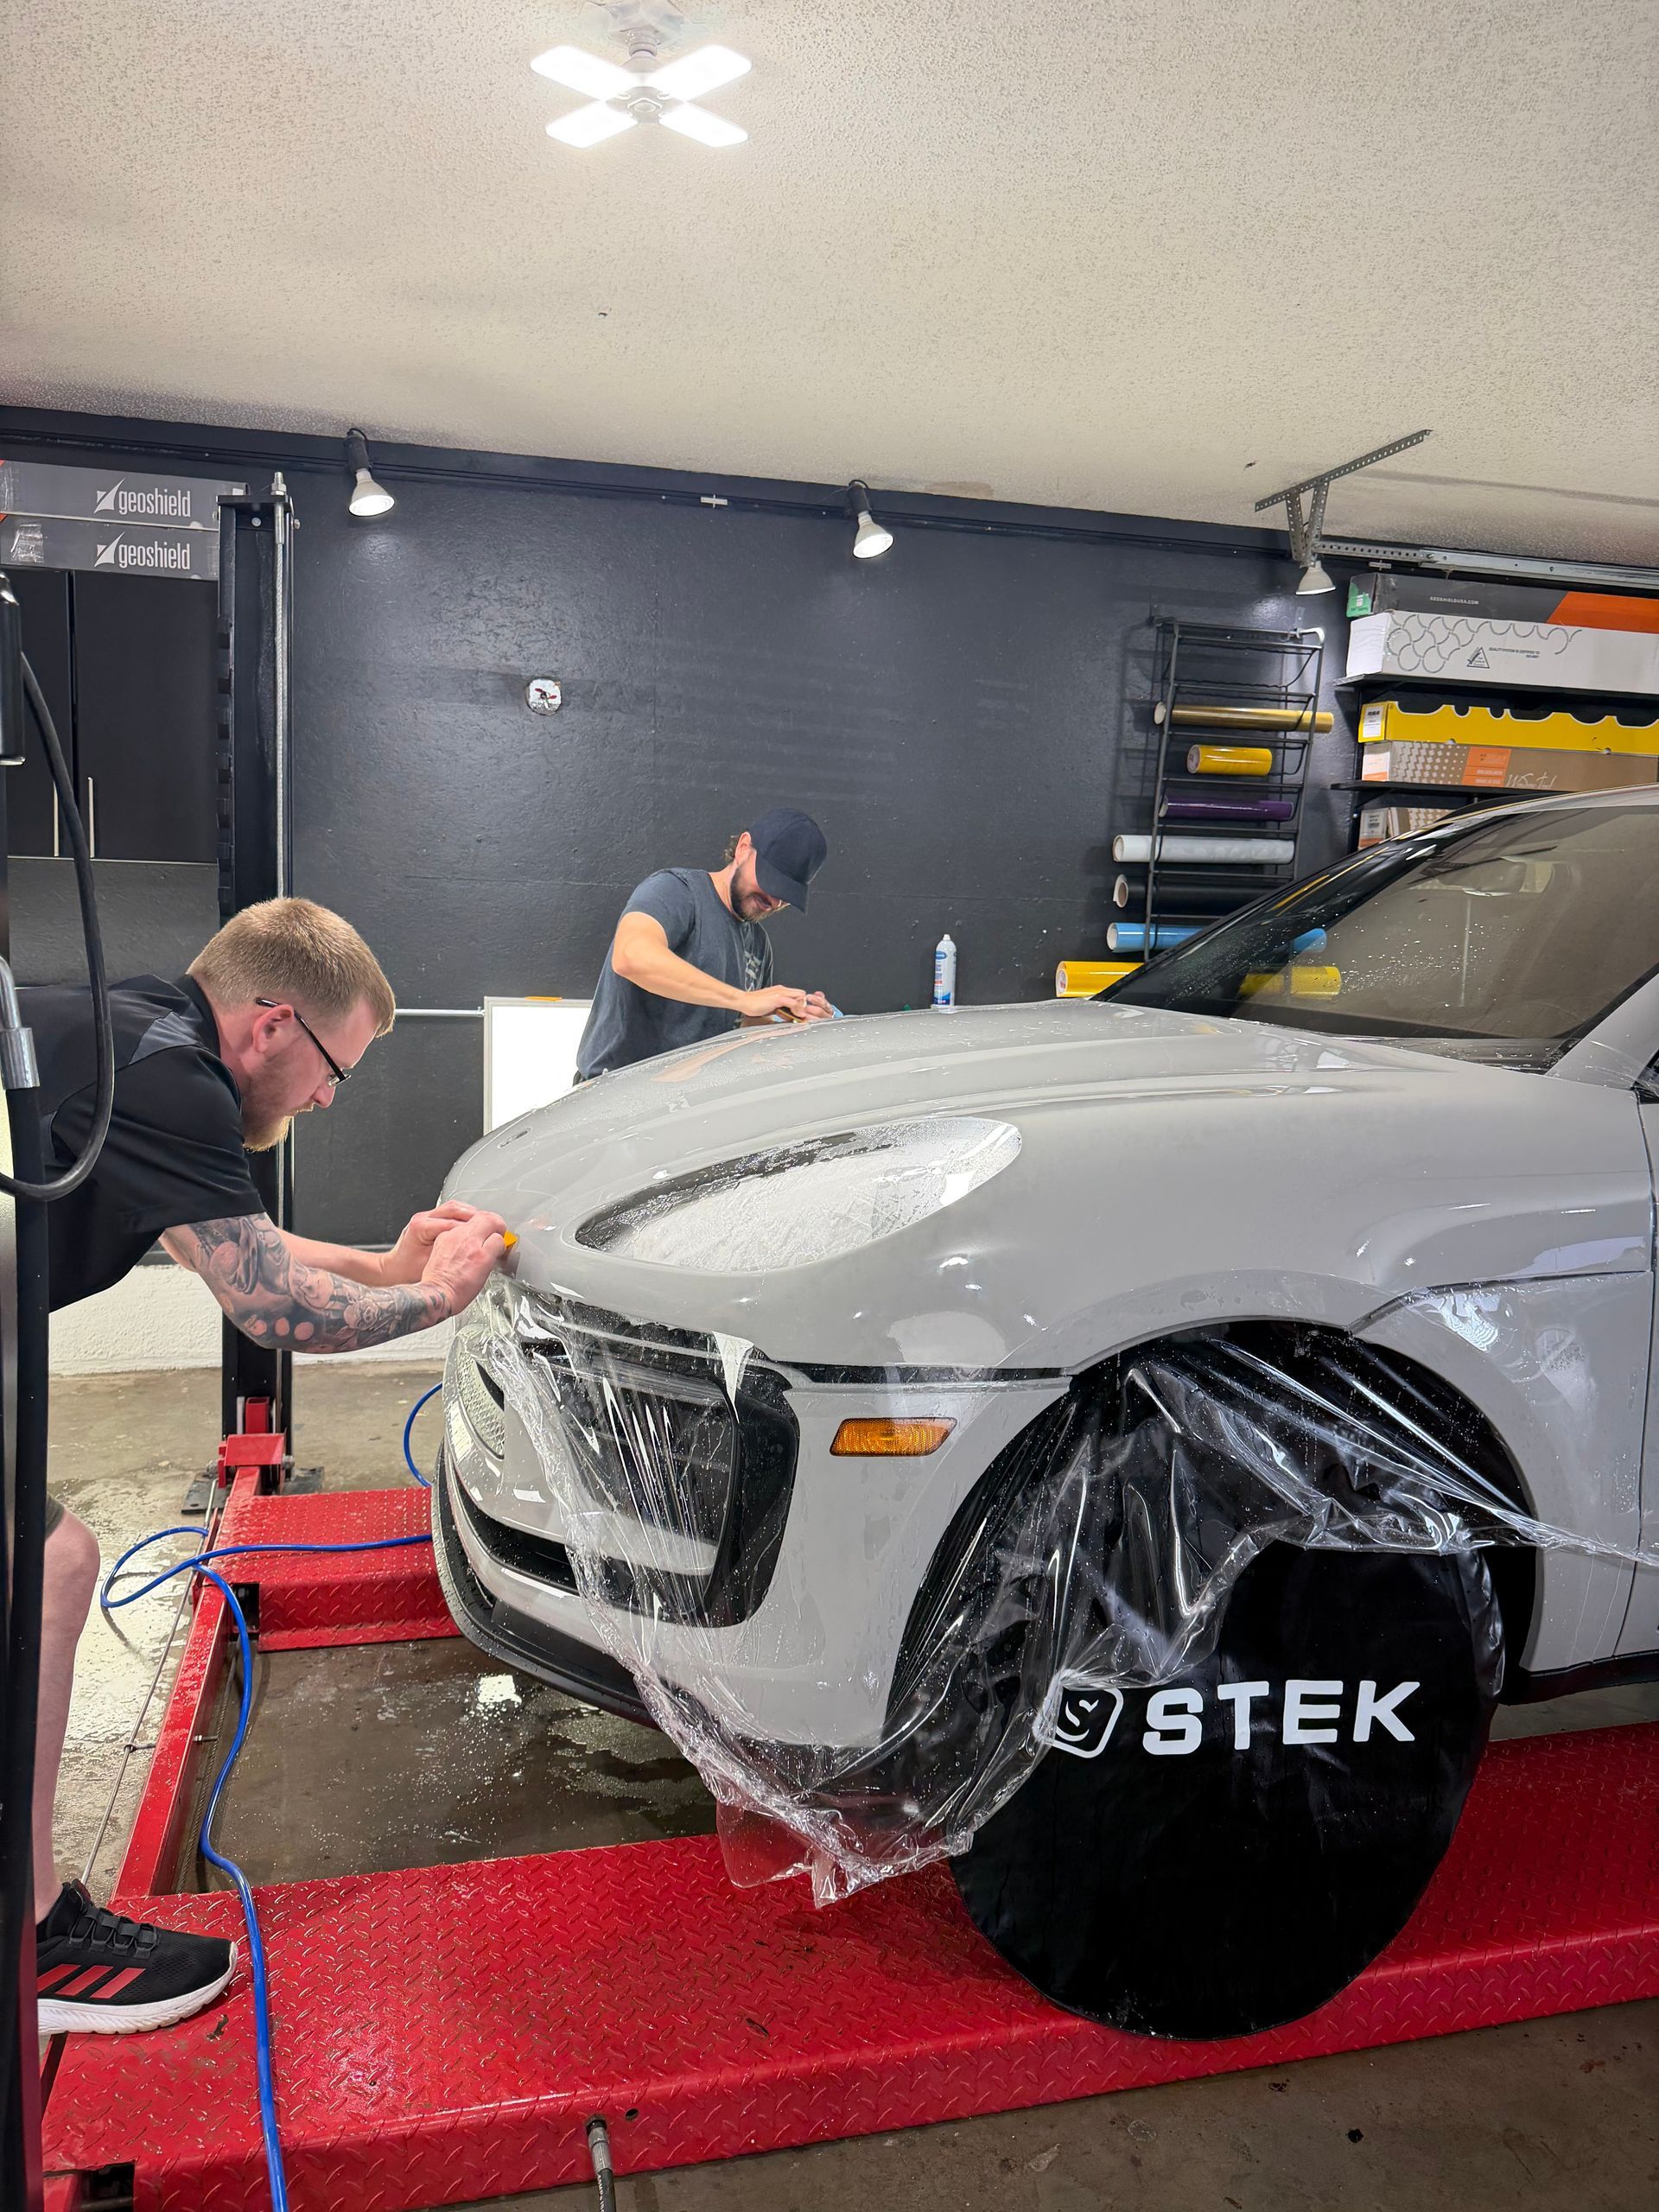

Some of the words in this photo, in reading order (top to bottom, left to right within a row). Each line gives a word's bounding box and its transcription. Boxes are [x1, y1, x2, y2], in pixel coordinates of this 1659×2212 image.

[118, 487, 191, 518] geoshield
[118, 541, 190, 570] geoshield
[1142, 1679, 1421, 1755] STEK
